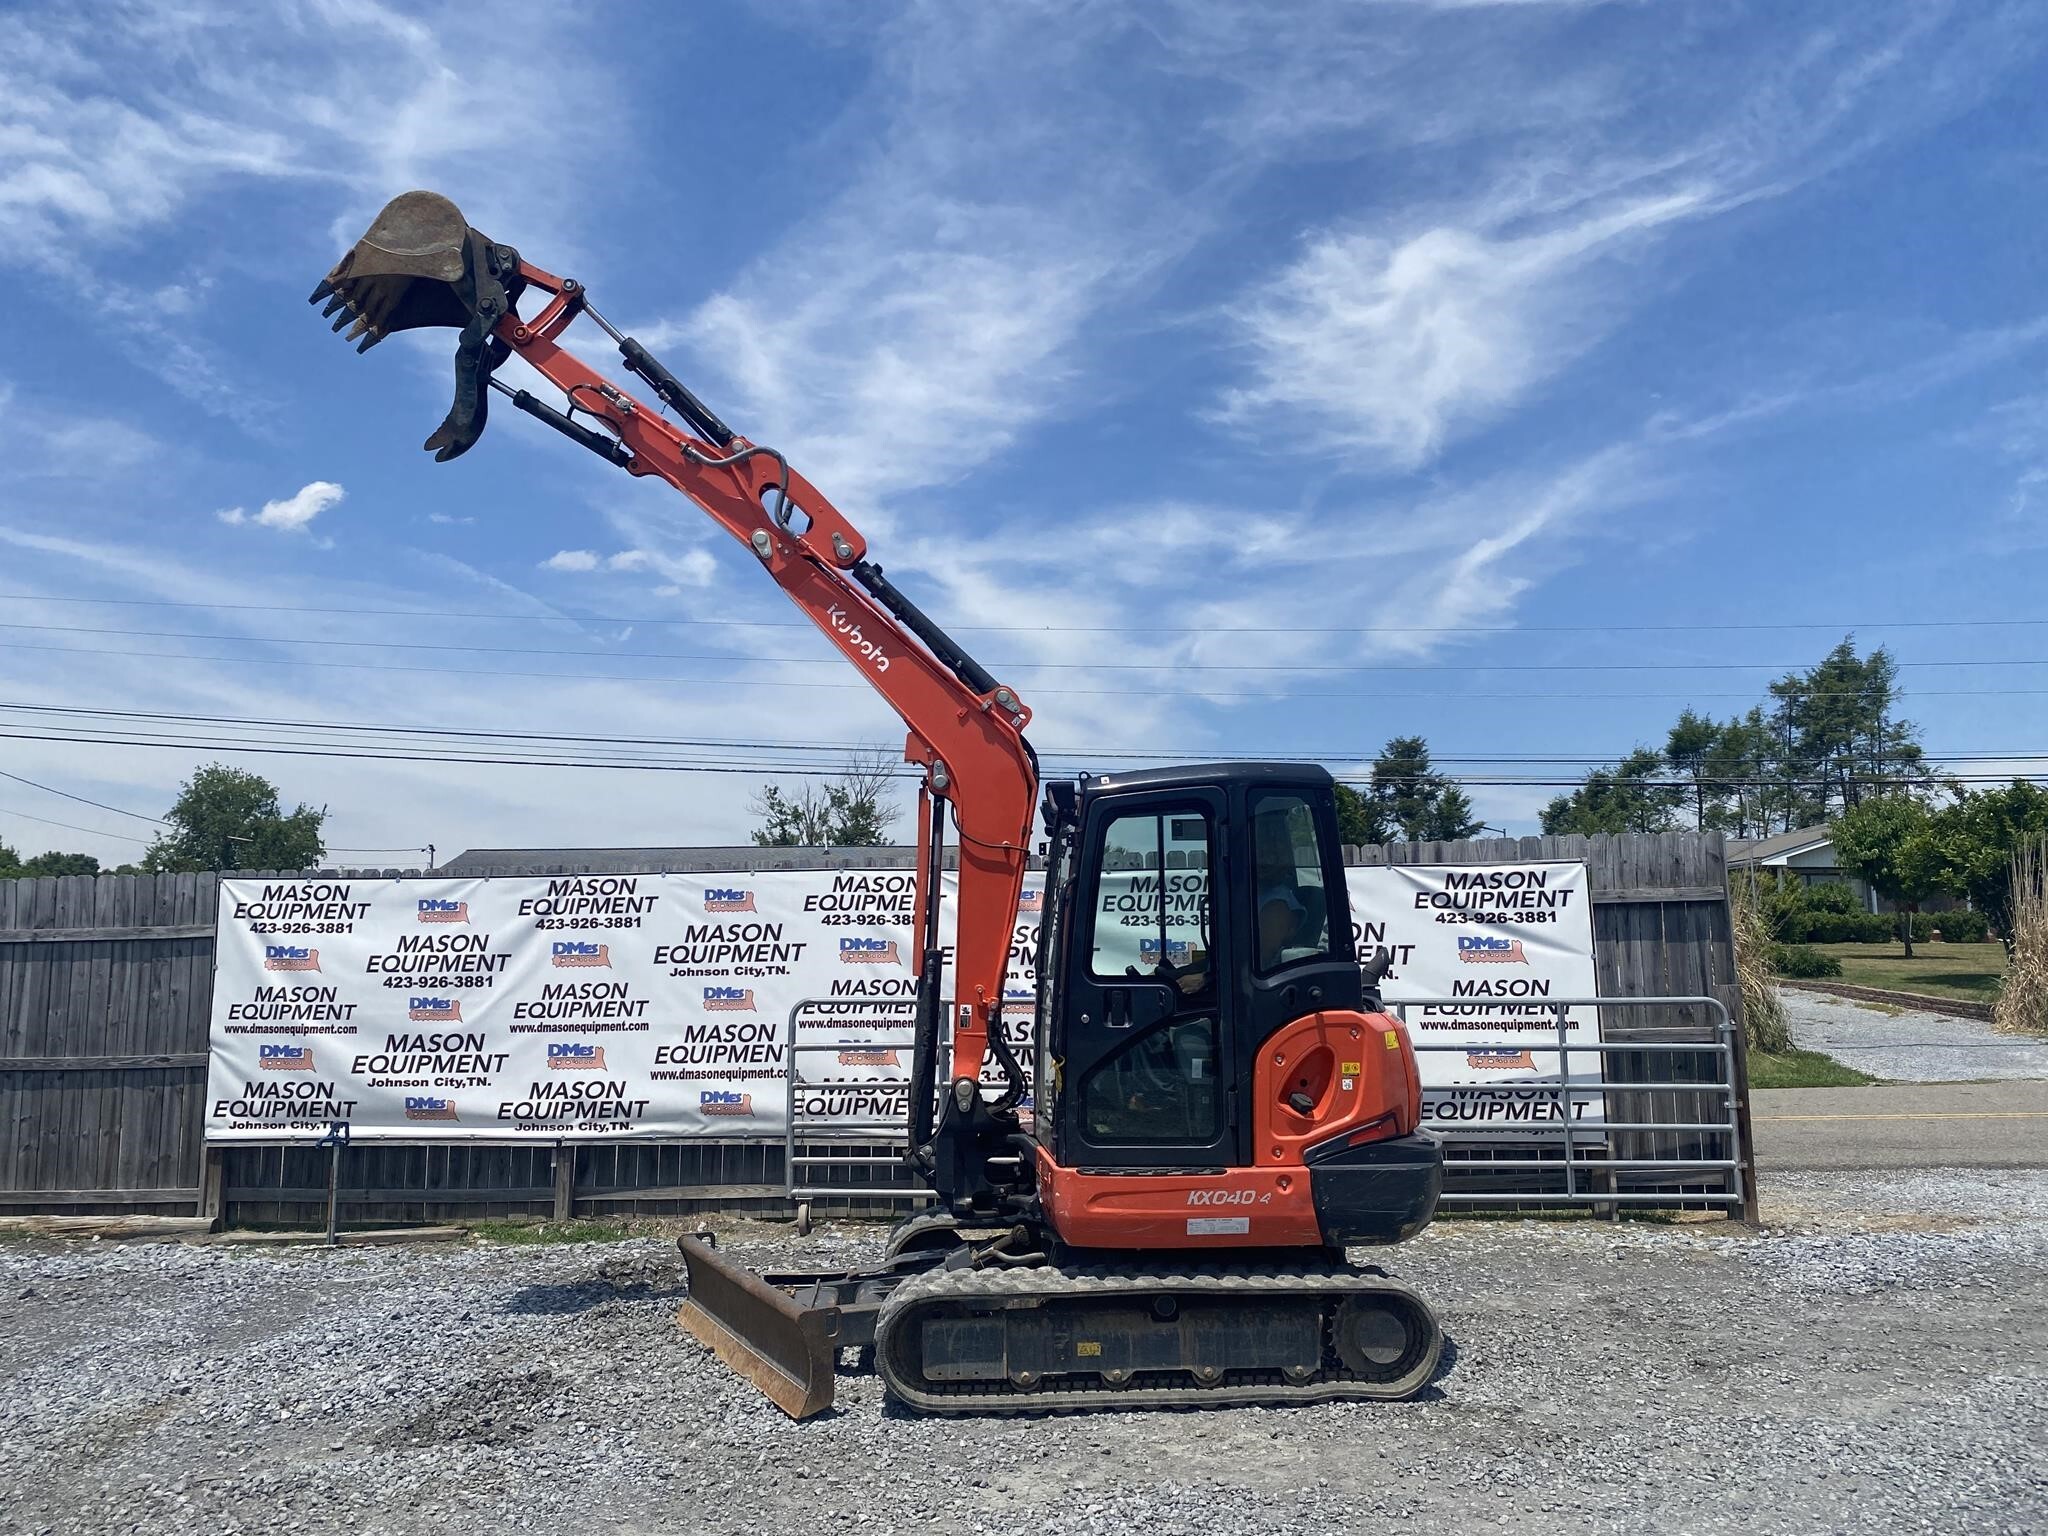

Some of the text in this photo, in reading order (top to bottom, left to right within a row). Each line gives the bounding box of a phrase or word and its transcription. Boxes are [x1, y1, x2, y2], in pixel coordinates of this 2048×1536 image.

[827, 603, 889, 672] Kubota
[547, 878, 637, 896] MASON
[1444, 871, 1546, 890] MASON
[262, 885, 350, 901] MASON
[1414, 890, 1574, 909] EQUIPMENT
[233, 903, 371, 920] EQUIPMENT
[518, 896, 659, 916] EQUIPMENT
[803, 894, 947, 912] EQUIPME
[535, 918, 642, 930] 423-926-3881
[1435, 911, 1557, 924] 423-926-3881
[249, 923, 353, 934] 423-926-3881
[685, 923, 782, 943] MASON
[396, 934, 489, 952] MASON
[653, 944, 807, 964] EQUIPMENT
[366, 954, 512, 973] EQUIPMENT
[669, 966, 790, 978] Johnson City,TN.
[383, 976, 493, 988] 423-926-3881
[830, 979, 919, 996] MASON
[1452, 980, 1550, 996] MASON
[254, 986, 337, 1002] MASON
[541, 982, 628, 1000] MASON
[228, 1004, 357, 1020] EQUIPMENT
[514, 1000, 650, 1019] EQUIPMENT
[224, 1024, 357, 1036] www.dmasonequipment.com
[510, 1022, 650, 1035] www.dmasonequipment.com
[798, 1018, 915, 1031] www.dmasonequipmen
[684, 1024, 776, 1043] MASON
[384, 1034, 485, 1053] MASON
[654, 1044, 788, 1065] EQUIPMEN
[351, 1054, 509, 1074] EQUIPMENT
[368, 1078, 492, 1089] Johnson City,TN.
[650, 1069, 799, 1082] www.dmasonequipment.co
[243, 1082, 334, 1099] MASON
[528, 1081, 626, 1100] MASON
[213, 1101, 357, 1118] EQUIPMENT
[498, 1100, 650, 1120] EQUIPMENT
[1420, 1102, 1590, 1120] EQUIPMENT
[228, 1120, 345, 1131] Johnson City,T
[514, 1122, 634, 1133] Johnson City,TN.
